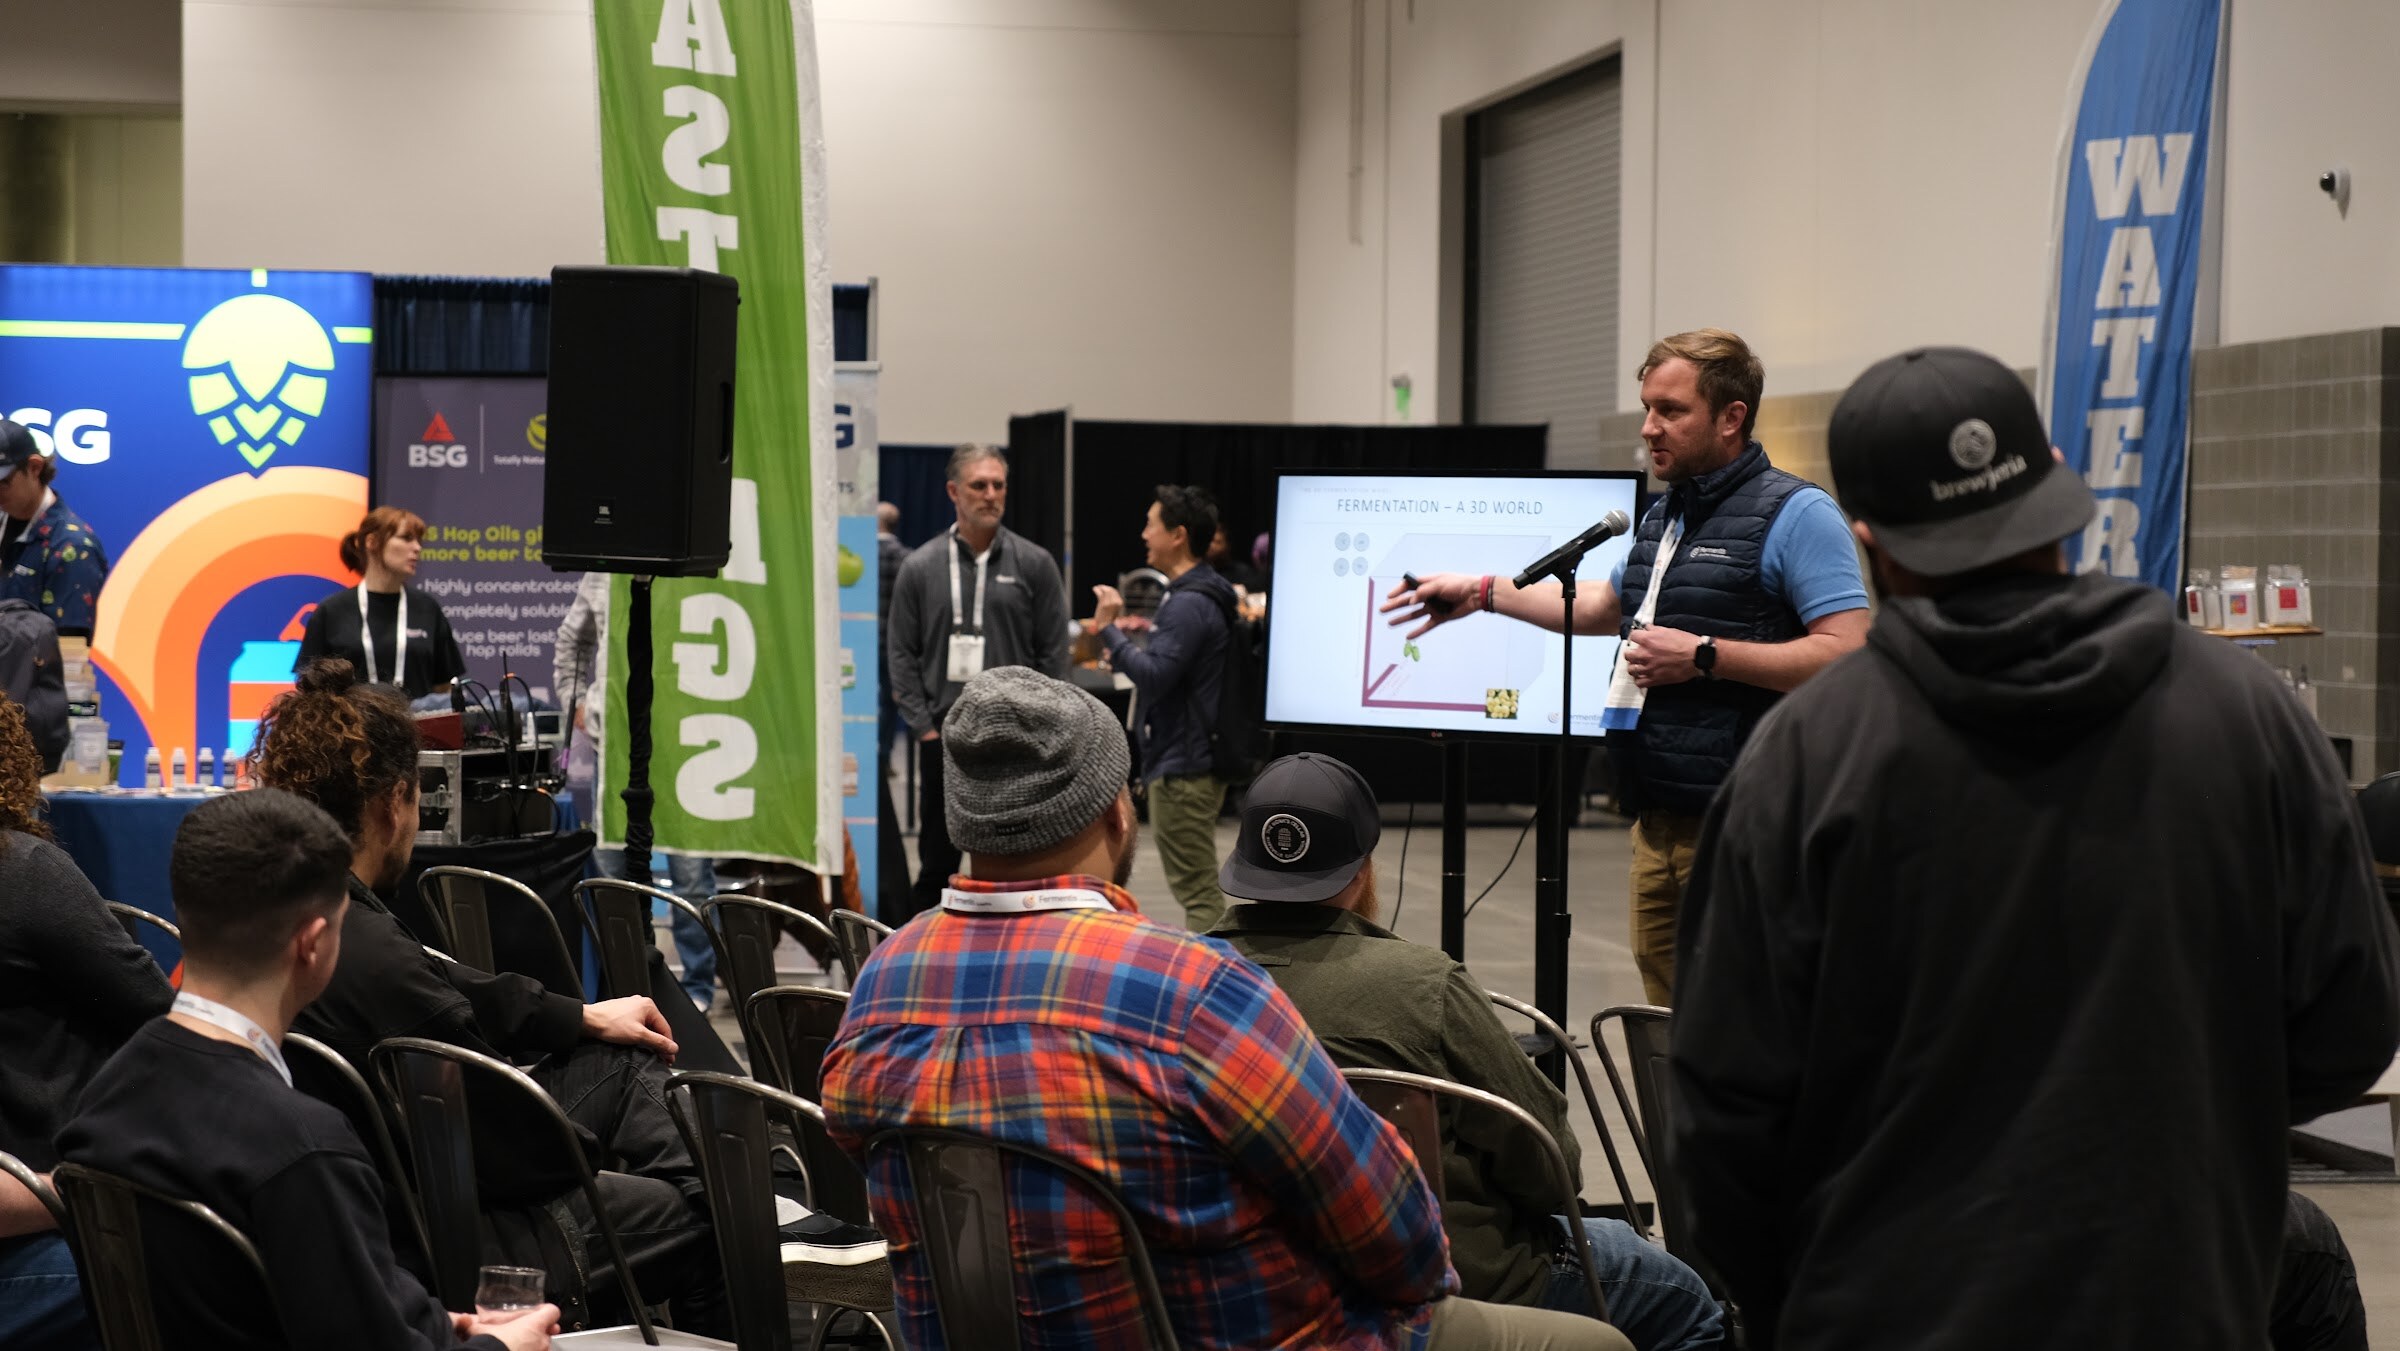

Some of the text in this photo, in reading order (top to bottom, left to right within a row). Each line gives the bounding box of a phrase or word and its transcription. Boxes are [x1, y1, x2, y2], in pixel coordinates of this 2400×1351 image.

[2076, 133, 2193, 577] WATER
[0, 407, 111, 465] SG
[408, 444, 468, 468] BSG
[1337, 498, 1439, 513] FERMENTATION
[1456, 501, 1465, 513] A
[1470, 500, 1488, 514] 3D
[1493, 501, 1543, 515] WORLD
[443, 526, 481, 546] Hop
[485, 525, 521, 543] Oils
[420, 548, 470, 562] more
[475, 545, 519, 562] beer
[424, 578, 471, 597] highly
[441, 602, 518, 622] ompletely
[488, 629, 525, 644] beer
[528, 629, 557, 644] lost
[466, 643, 541, 660] hop solids
